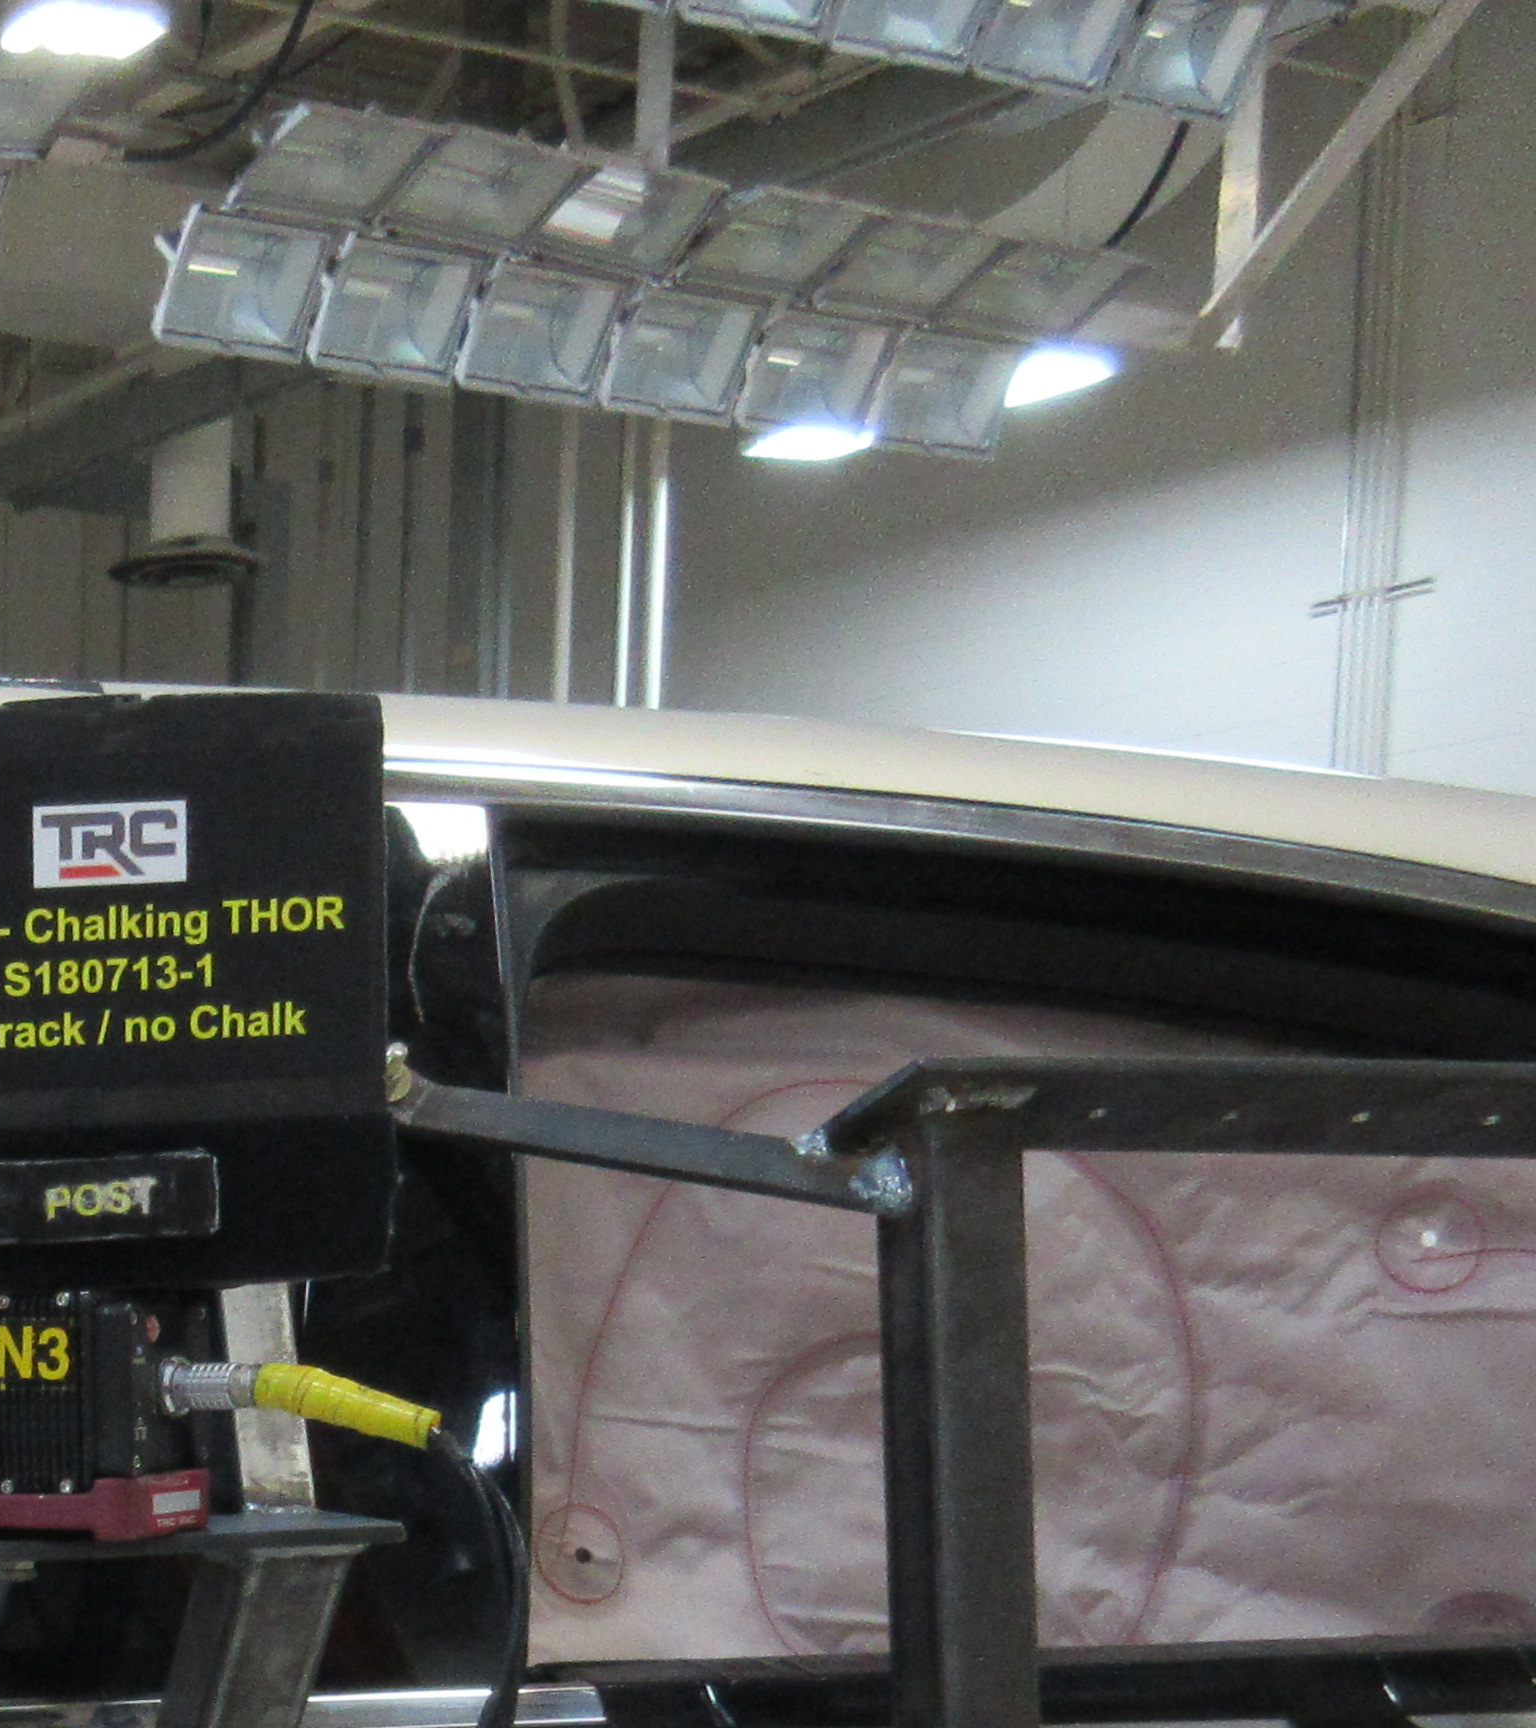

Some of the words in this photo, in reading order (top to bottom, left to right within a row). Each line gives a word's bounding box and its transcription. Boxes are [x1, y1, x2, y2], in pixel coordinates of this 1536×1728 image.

[41, 808, 177, 877] TRC
[24, 904, 209, 946] Chalking
[221, 894, 345, 935] THOR
[3, 953, 213, 998] S180713-1
[96, 1009, 111, 1046] /
[124, 1015, 177, 1044] no
[189, 1000, 307, 1040] Chalk
[45, 1176, 158, 1222] POST
